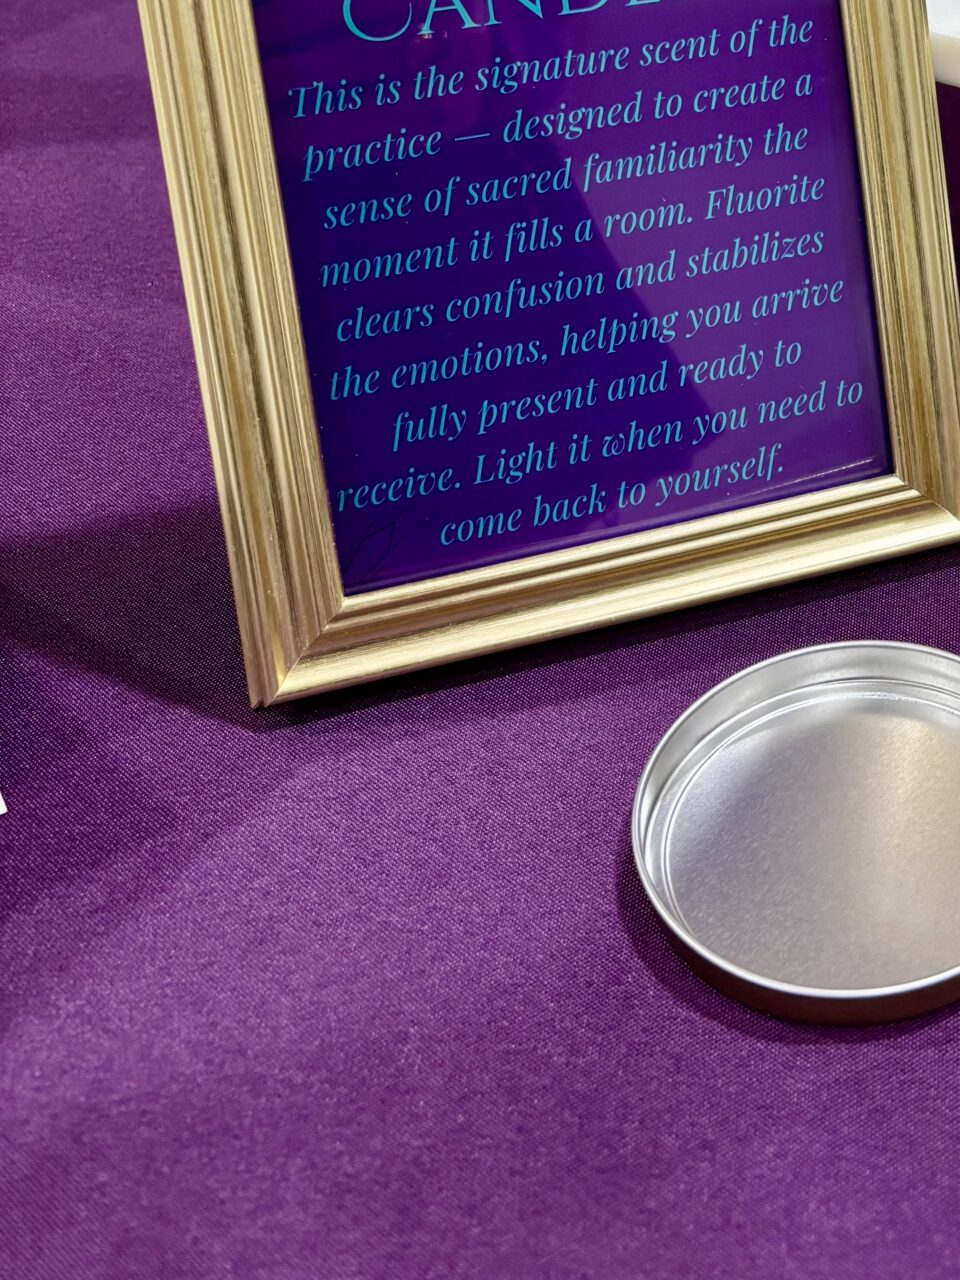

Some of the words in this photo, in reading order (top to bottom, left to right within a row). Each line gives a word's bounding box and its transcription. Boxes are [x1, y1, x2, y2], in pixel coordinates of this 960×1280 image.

[287, 79, 363, 119] This
[375, 74, 402, 106] is
[413, 66, 465, 100] the
[474, 45, 630, 95] signature
[640, 30, 720, 65] scent
[729, 18, 765, 56] of
[769, 14, 815, 47] the
[303, 131, 443, 182] practice
[502, 90, 643, 143] designed
[655, 87, 686, 119] to
[692, 74, 785, 113] create
[794, 73, 813, 97] a
[324, 185, 414, 229] sense
[424, 176, 460, 214] of
[466, 158, 573, 204] sacred
[582, 136, 754, 192] familiarity
[763, 123, 809, 155] the
[319, 237, 460, 288] moment
[468, 229, 494, 262] it
[503, 216, 565, 263] fills
[573, 218, 595, 244] a
[603, 199, 694, 238] room.
[704, 173, 827, 220] Fluorite
[336, 296, 435, 344] clears
[445, 272, 606, 324] confusion
[615, 249, 677, 291] and
[685, 228, 826, 277] stabilizes
[330, 366, 381, 401] the
[391, 339, 548, 389] emotions,
[559, 310, 679, 357] helping
[686, 299, 744, 337] you
[750, 277, 846, 318] arrive
[337, 466, 462, 512] receive.
[473, 437, 559, 487] Light
[568, 429, 593, 465] it
[600, 419, 684, 458] when
[692, 405, 749, 441] you
[757, 380, 827, 424] need
[836, 379, 864, 405] to
[391, 402, 468, 452] fully
[477, 377, 599, 436] present
[606, 360, 668, 402] and
[677, 345, 765, 387] ready
[774, 341, 803, 367] to
[439, 505, 524, 547] come
[531, 483, 608, 529] back
[616, 479, 648, 510] to
[654, 443, 787, 501] yourself.
